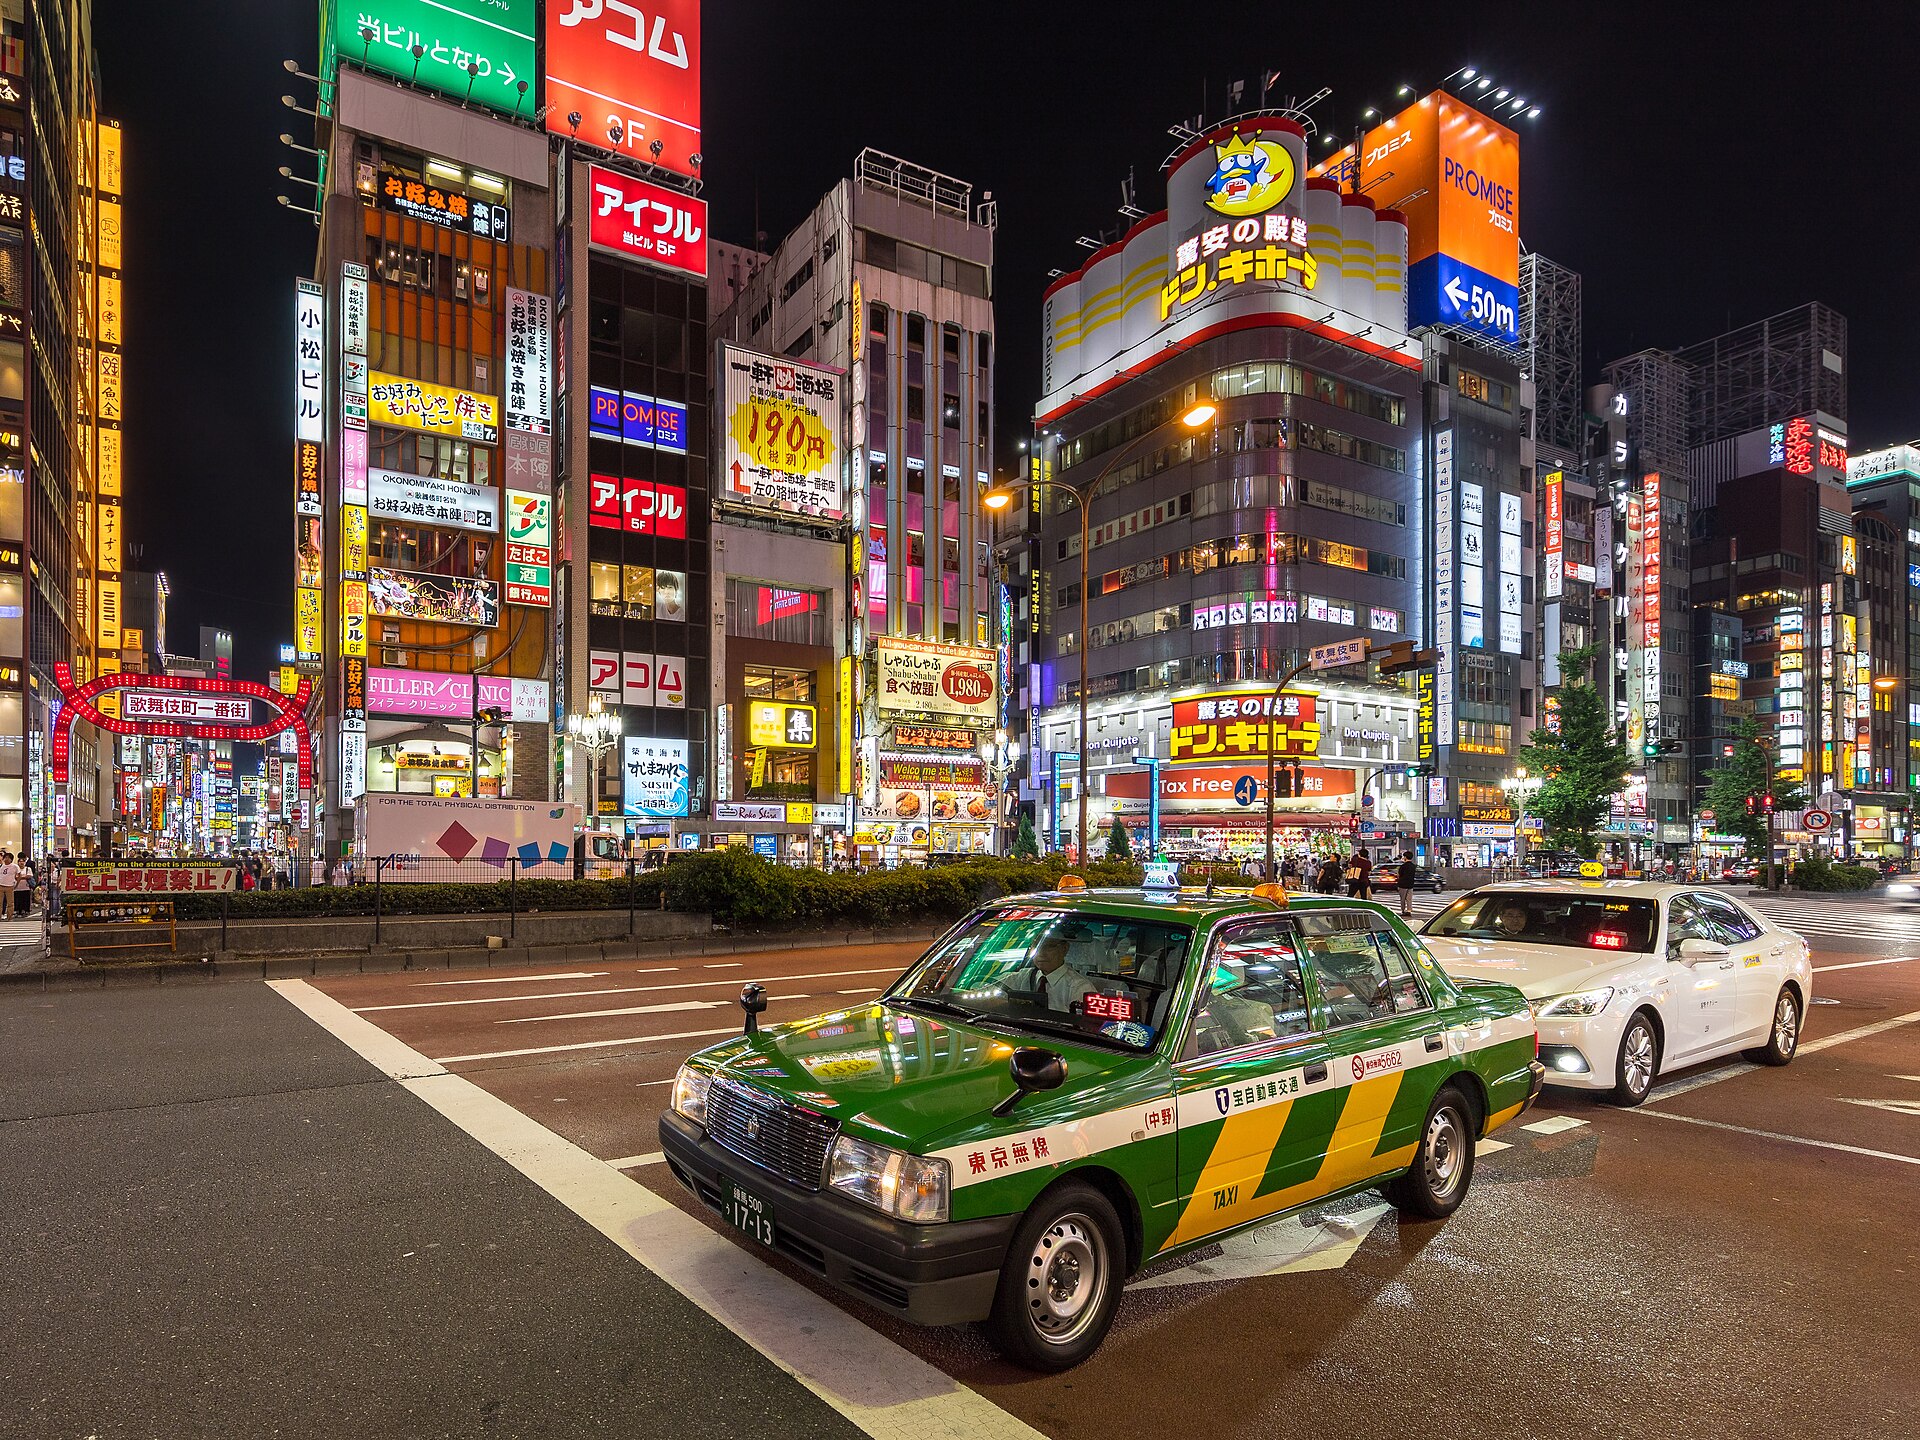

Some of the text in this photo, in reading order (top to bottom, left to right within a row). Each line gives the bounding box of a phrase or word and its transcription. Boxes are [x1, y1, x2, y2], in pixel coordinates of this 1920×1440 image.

[357, 12, 492, 77] 当ビルとなり
[559, 0, 690, 70] アコム
[110, 120, 120, 129] 10
[1366, 129, 1413, 168] プロミス
[384, 176, 468, 218] お好み焼
[1445, 156, 1513, 216] PROMISE
[472, 202, 489, 235] 本陣
[493, 218, 505, 230] 8F
[594, 183, 702, 244] アイフル
[1488, 209, 1514, 234] プロミス
[623, 230, 677, 258] 当ビル 5F
[1176, 214, 1307, 272] 驚安の殿堂
[111, 271, 118, 279] 8
[1470, 284, 1515, 334] 50m
[300, 308, 321, 420] 小松ビル
[510, 303, 527, 411] お好み焼き本陣
[539, 298, 548, 416] OKONOMIYAKI HONJIN
[372, 382, 421, 401] お好み
[731, 360, 835, 401] 一軒め酒場
[388, 396, 448, 416] もんじゃ
[454, 393, 493, 421] 焼き
[596, 397, 679, 431] PROMISE
[112, 421, 118, 429] 6
[421, 411, 454, 427] たこ
[484, 427, 497, 441] 7F
[645, 426, 678, 442] プロミス
[748, 405, 825, 460] 190円
[302, 443, 317, 492] お好み焼
[508, 455, 550, 479] 本陣
[1846, 462, 1898, 480] 容外科
[1857, 452, 1897, 469] 水の森
[382, 474, 481, 497] OKONOMIYAKI HONJIN
[748, 466, 807, 487] 一軒め酒場
[593, 480, 683, 520] アイフル
[753, 480, 830, 507] 左の路地を右へ
[303, 502, 317, 512] 8F
[373, 497, 491, 525] お好み焼き本陣 2F
[631, 518, 646, 529] 5F
[1643, 480, 1660, 607] カラオケパセラ
[509, 547, 548, 564] たばこ
[1613, 393, 1630, 723] カラオケパセラ
[111, 573, 118, 582] 4
[519, 567, 537, 582] 酒
[1439, 557, 1449, 608] 北の家族
[509, 586, 549, 604] 銀行ATM
[346, 582, 364, 641] 麻雀ブル
[349, 643, 362, 654] 6F
[881, 638, 936, 653] All-you-can-eat
[936, 645, 957, 656] buffet
[957, 649, 968, 657] for
[975, 650, 995, 660] hours
[1315, 642, 1360, 660] 歌舞伎町
[884, 652, 941, 671] しゃぶしゃぶ
[1323, 655, 1352, 665] Kabukicho
[347, 658, 363, 708] お好み焼
[591, 657, 682, 692] アコム
[367, 675, 511, 702] FILLER CLNIC
[949, 677, 981, 698] 1,980
[129, 697, 248, 719] 歌舞伎町一番街
[367, 697, 458, 713] フィラー クリニック
[524, 709, 537, 719] 3F
[1197, 697, 1300, 721] 驚安の殿堂
[348, 720, 362, 729] 8F
[787, 710, 812, 741] 集
[981, 717, 996, 729] 5F
[1344, 726, 1390, 742] Don Quijote
[1103, 734, 1139, 751] Quijote
[1160, 779, 1187, 794] Tax
[1192, 777, 1233, 793] Free
[379, 798, 535, 811] FOR THE TOTAL PHYSICAL DISTRIBUTION
[738, 806, 757, 820] Roko
[758, 807, 778, 819] Shira
[181, 861, 224, 869] prohibited.
[380, 853, 421, 870] ASAHI
[65, 869, 233, 892] 路上喫煙禁止!
[1147, 875, 1165, 884] 5662
[1594, 936, 1620, 947] 空車
[1087, 994, 1132, 1020] 空車
[1380, 1051, 1402, 1069] 5662
[1232, 1076, 1300, 1109] 宝自動車交通
[1144, 1106, 1176, 1132] (中野)
[967, 1137, 1051, 1176] 東京無線
[748, 1194, 763, 1214] 500
[1213, 1184, 1239, 1211] TAXI
[734, 1201, 772, 1246] 17-13
